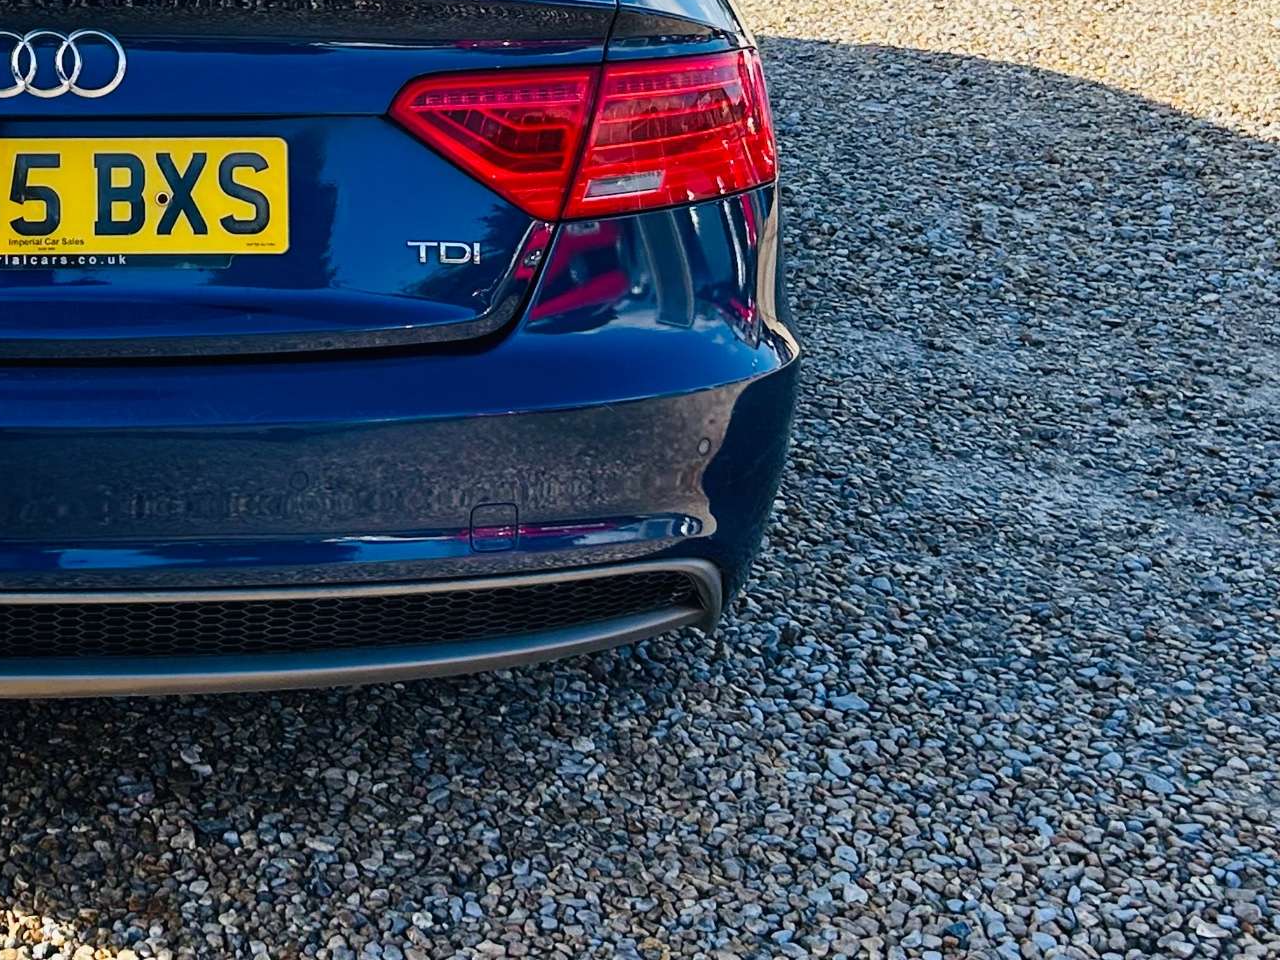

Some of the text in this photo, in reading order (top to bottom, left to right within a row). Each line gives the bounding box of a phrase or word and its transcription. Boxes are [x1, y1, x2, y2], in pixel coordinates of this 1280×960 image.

[93, 152, 271, 237] BXS
[8, 237, 85, 248] Imperial Car Sales
[406, 241, 481, 265] TDI
